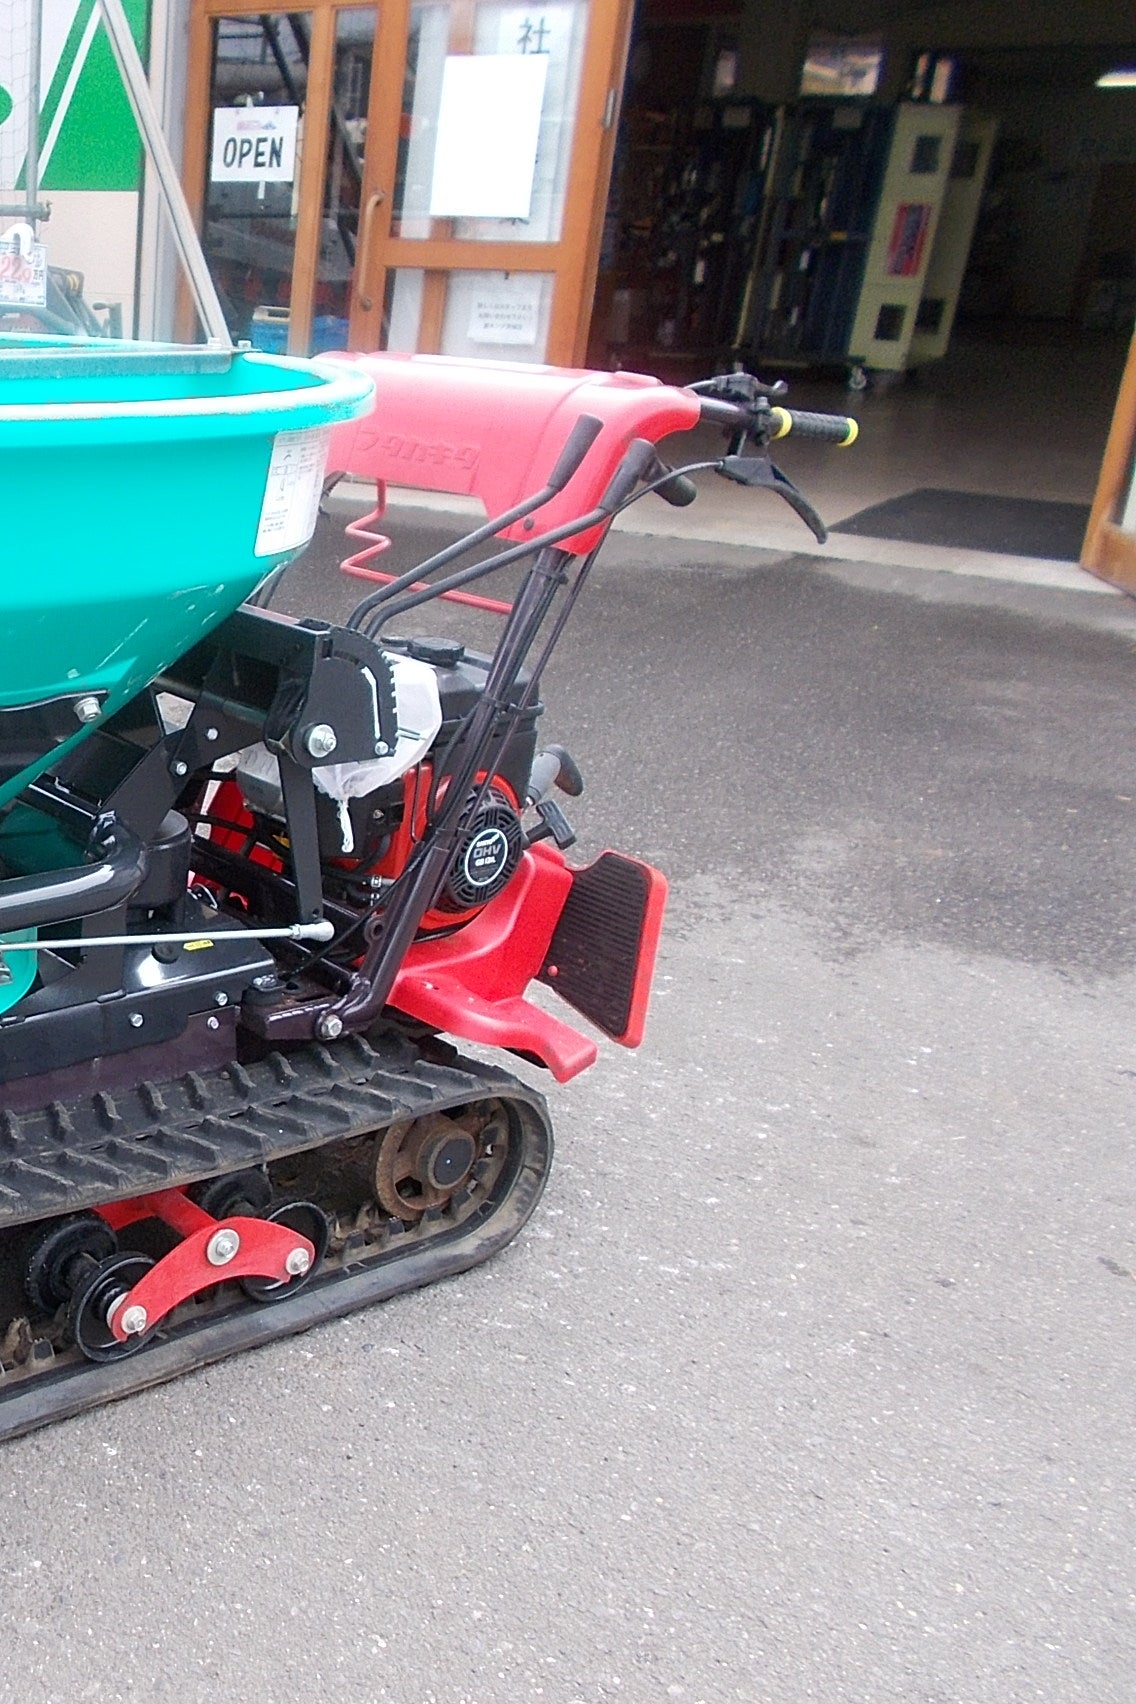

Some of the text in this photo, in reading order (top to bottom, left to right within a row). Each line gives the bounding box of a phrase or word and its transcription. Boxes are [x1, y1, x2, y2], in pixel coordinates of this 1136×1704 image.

[516, 16, 551, 55] 社
[223, 136, 283, 168] OPEN
[474, 843, 502, 858] OHV
